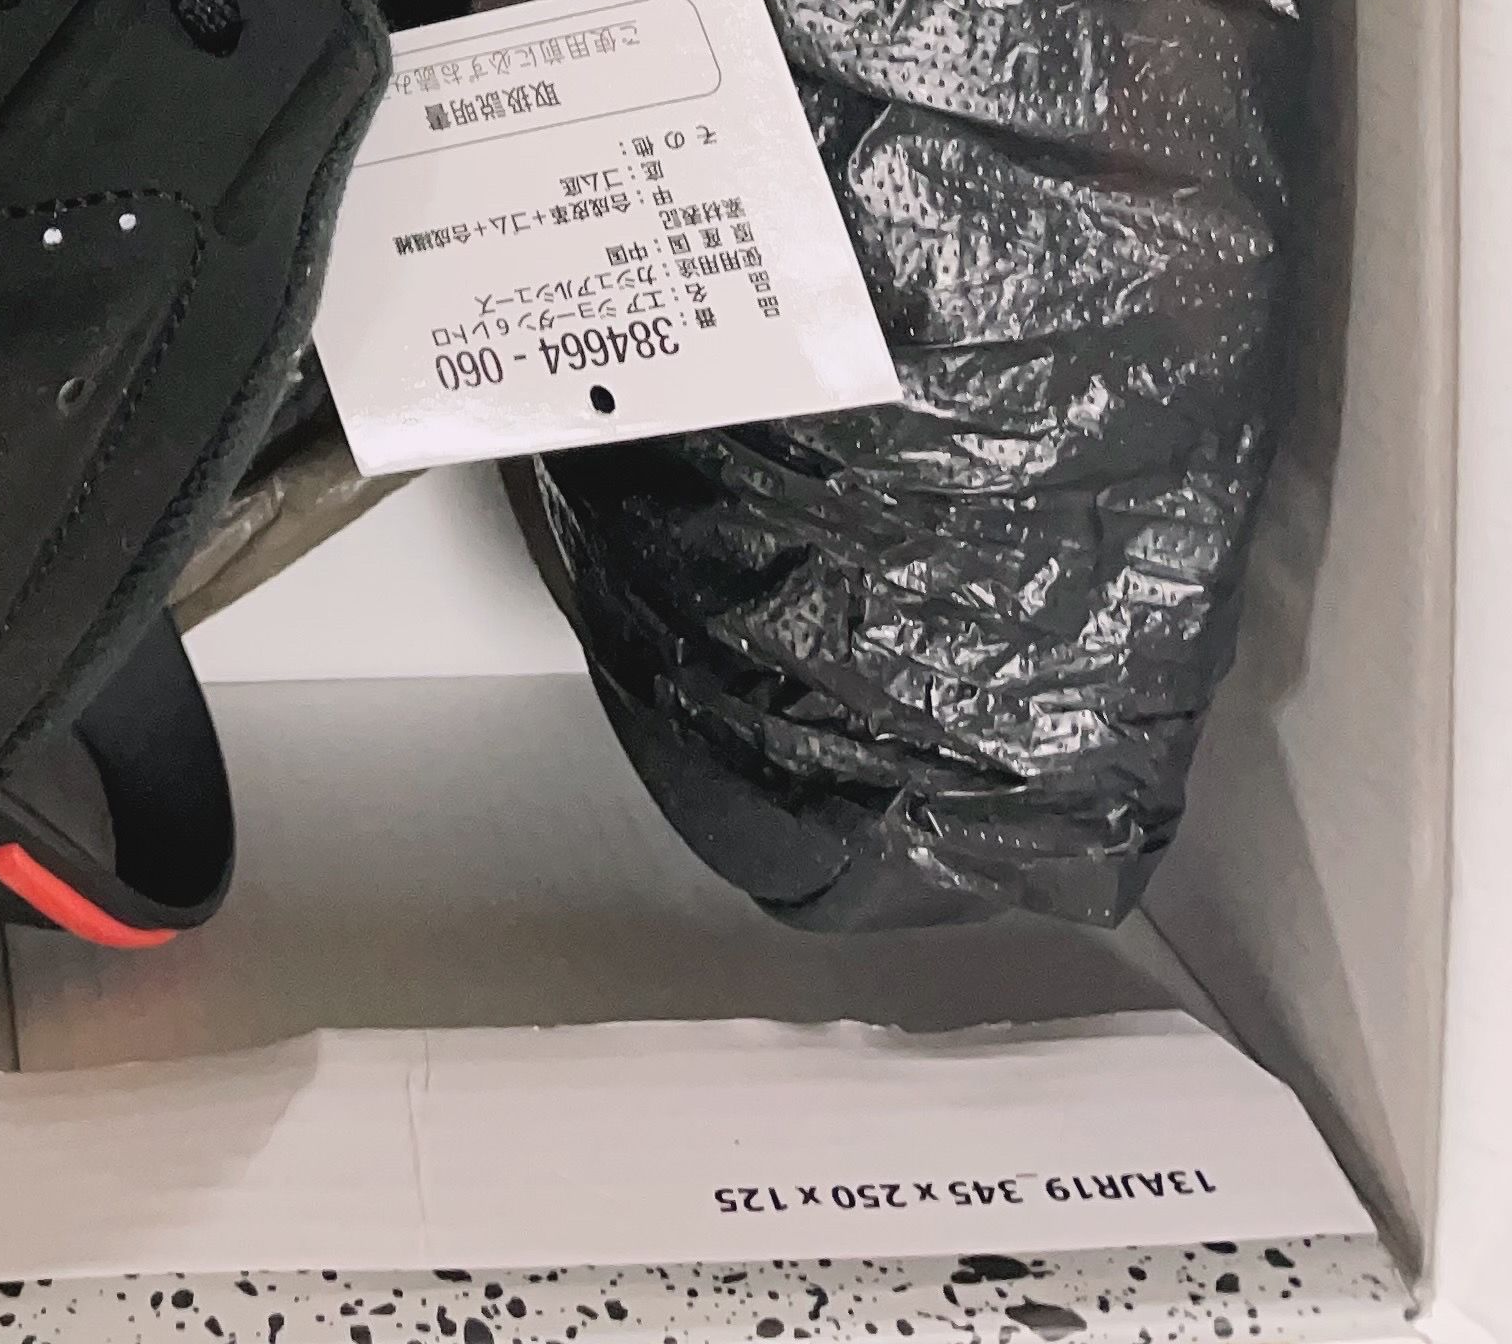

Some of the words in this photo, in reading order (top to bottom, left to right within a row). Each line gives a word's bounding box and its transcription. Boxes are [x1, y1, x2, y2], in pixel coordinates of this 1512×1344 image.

[386, 24, 641, 98] ご使用前に必ずお読み
[714, 1186, 789, 1213] 125
[831, 1182, 908, 1209] 250
